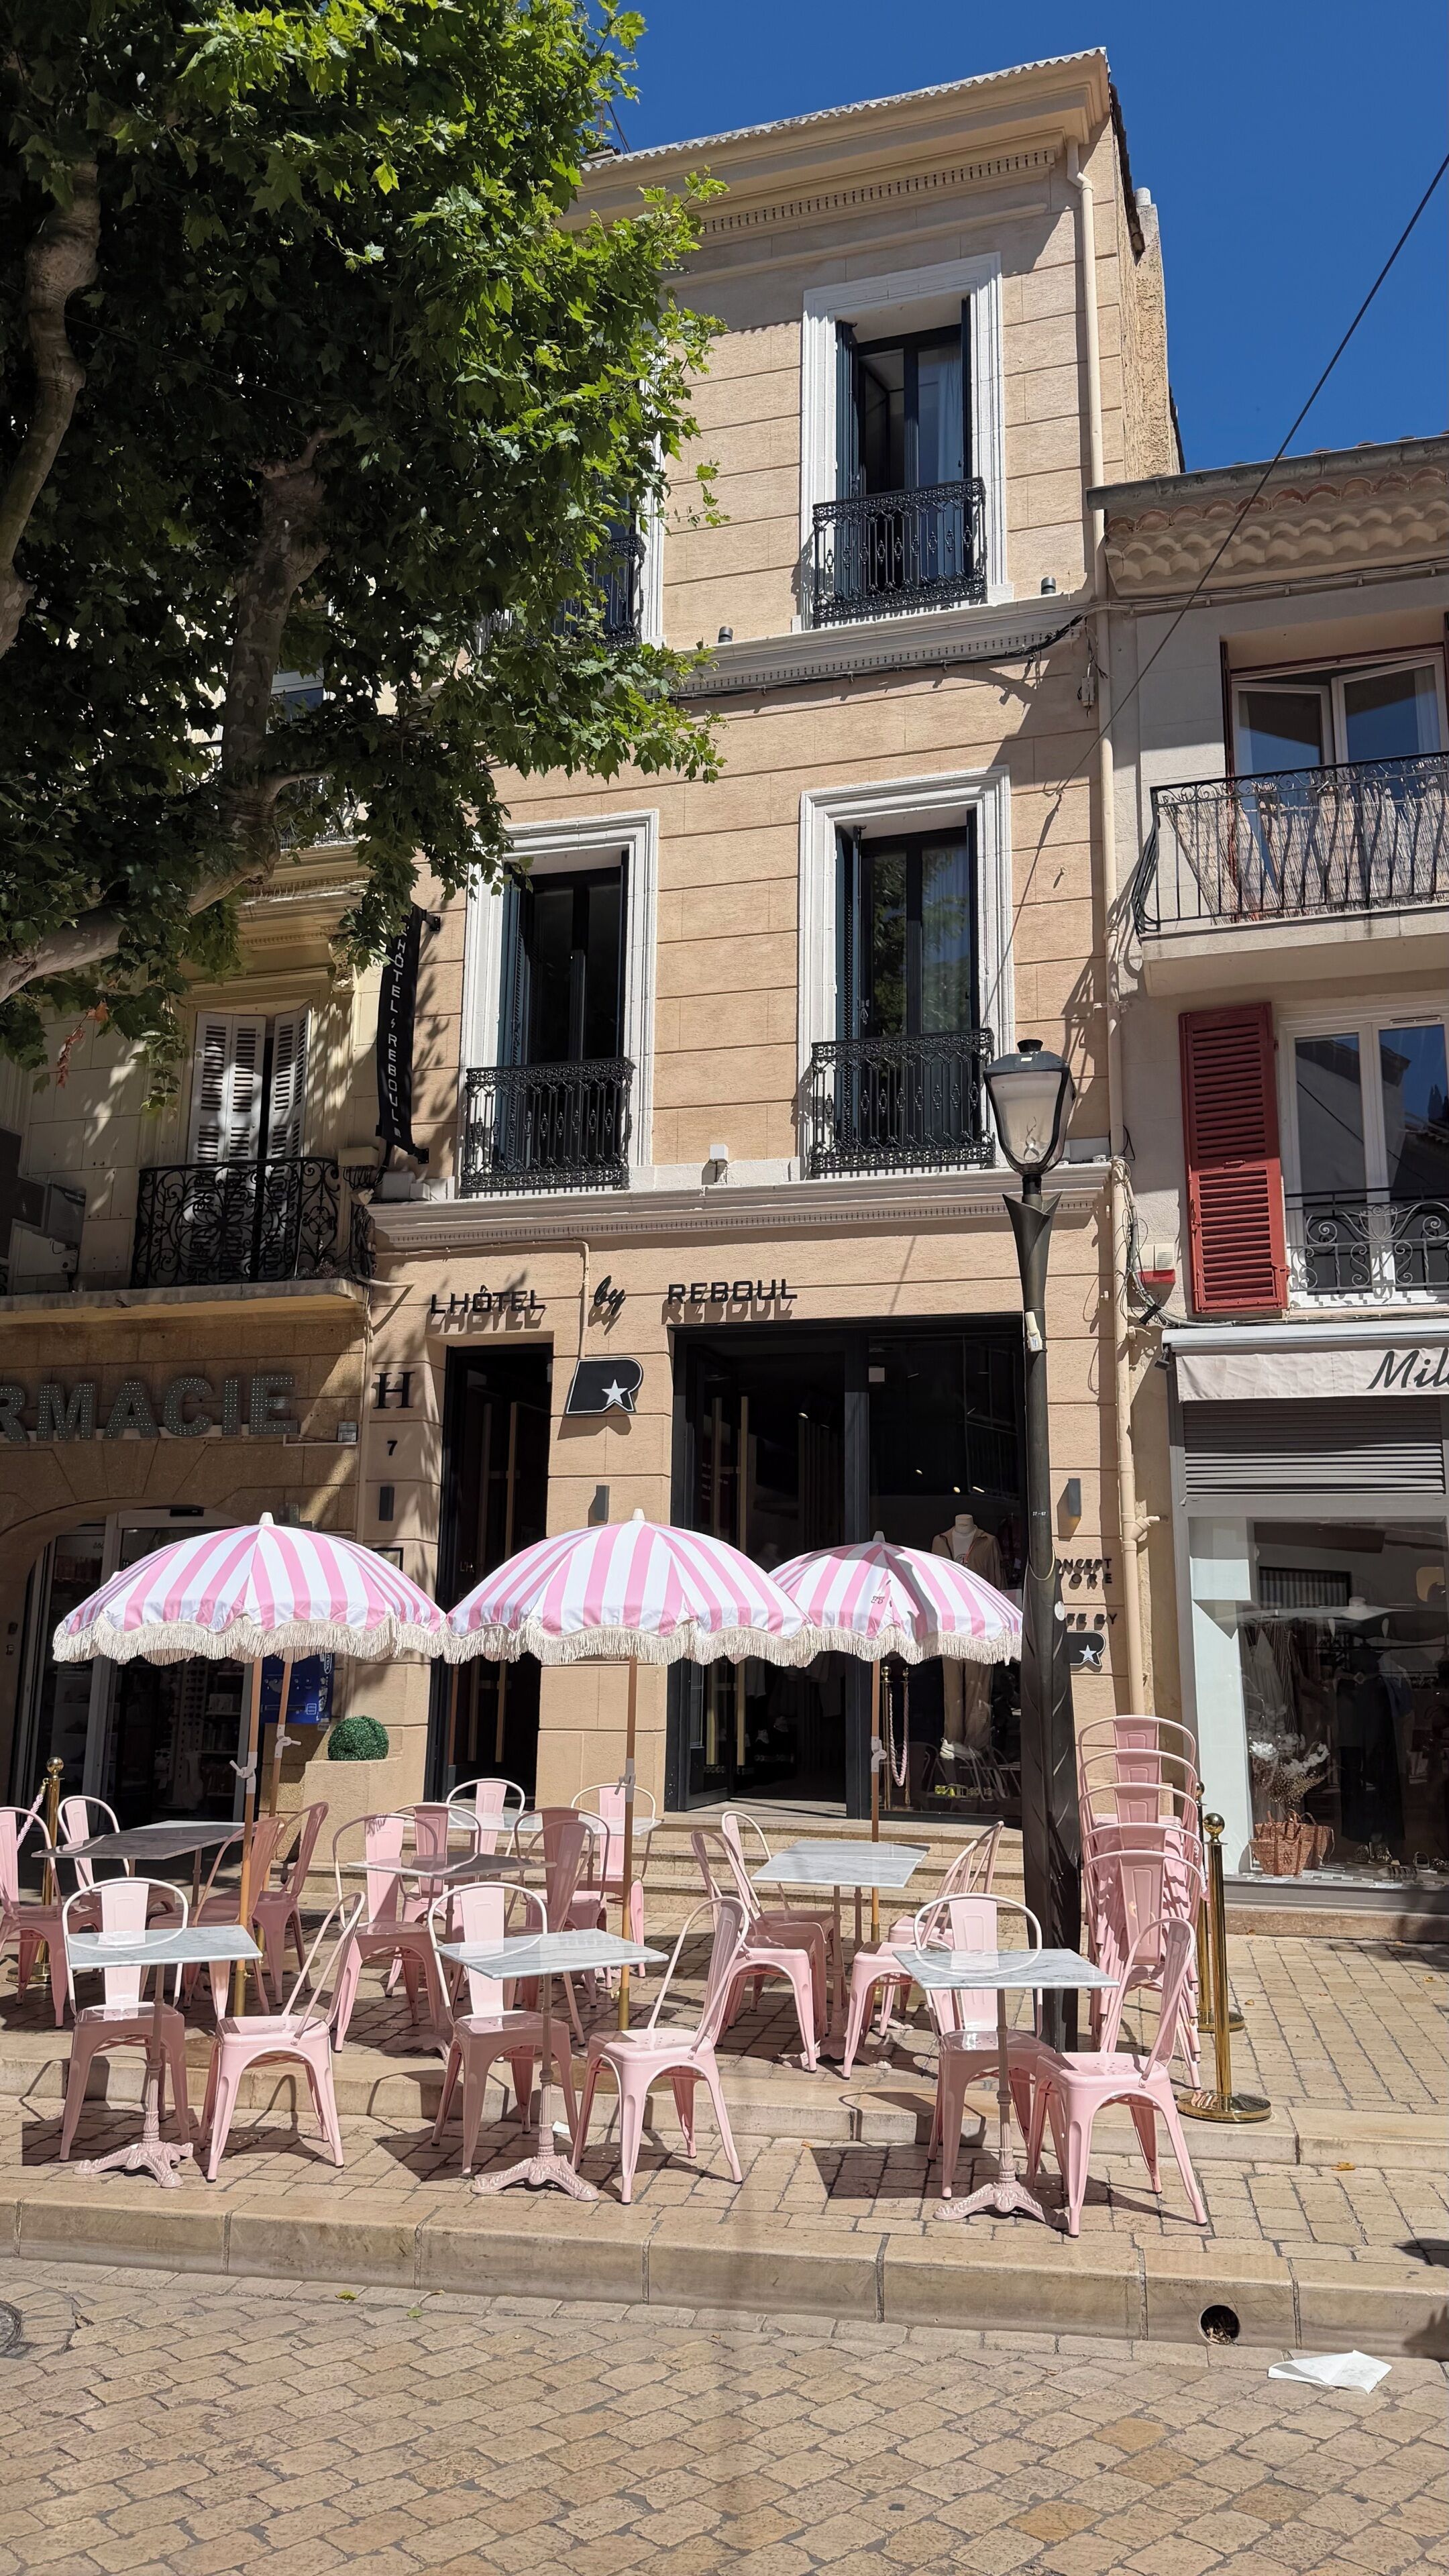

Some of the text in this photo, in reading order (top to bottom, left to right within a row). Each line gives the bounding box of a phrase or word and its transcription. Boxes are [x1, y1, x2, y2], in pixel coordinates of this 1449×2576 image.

[388, 1033, 399, 1122] REBOUL
[594, 1275, 626, 1316] by
[667, 1279, 798, 1305] REBOUL
[1366, 1347, 1449, 1390] Mil
[373, 1371, 415, 1409] H
[386, 1440, 398, 1456] 7
[1055, 1558, 1112, 1569] ONCEPT
[1059, 1573, 1113, 1584] ORE
[1095, 1613, 1118, 1625] BY
